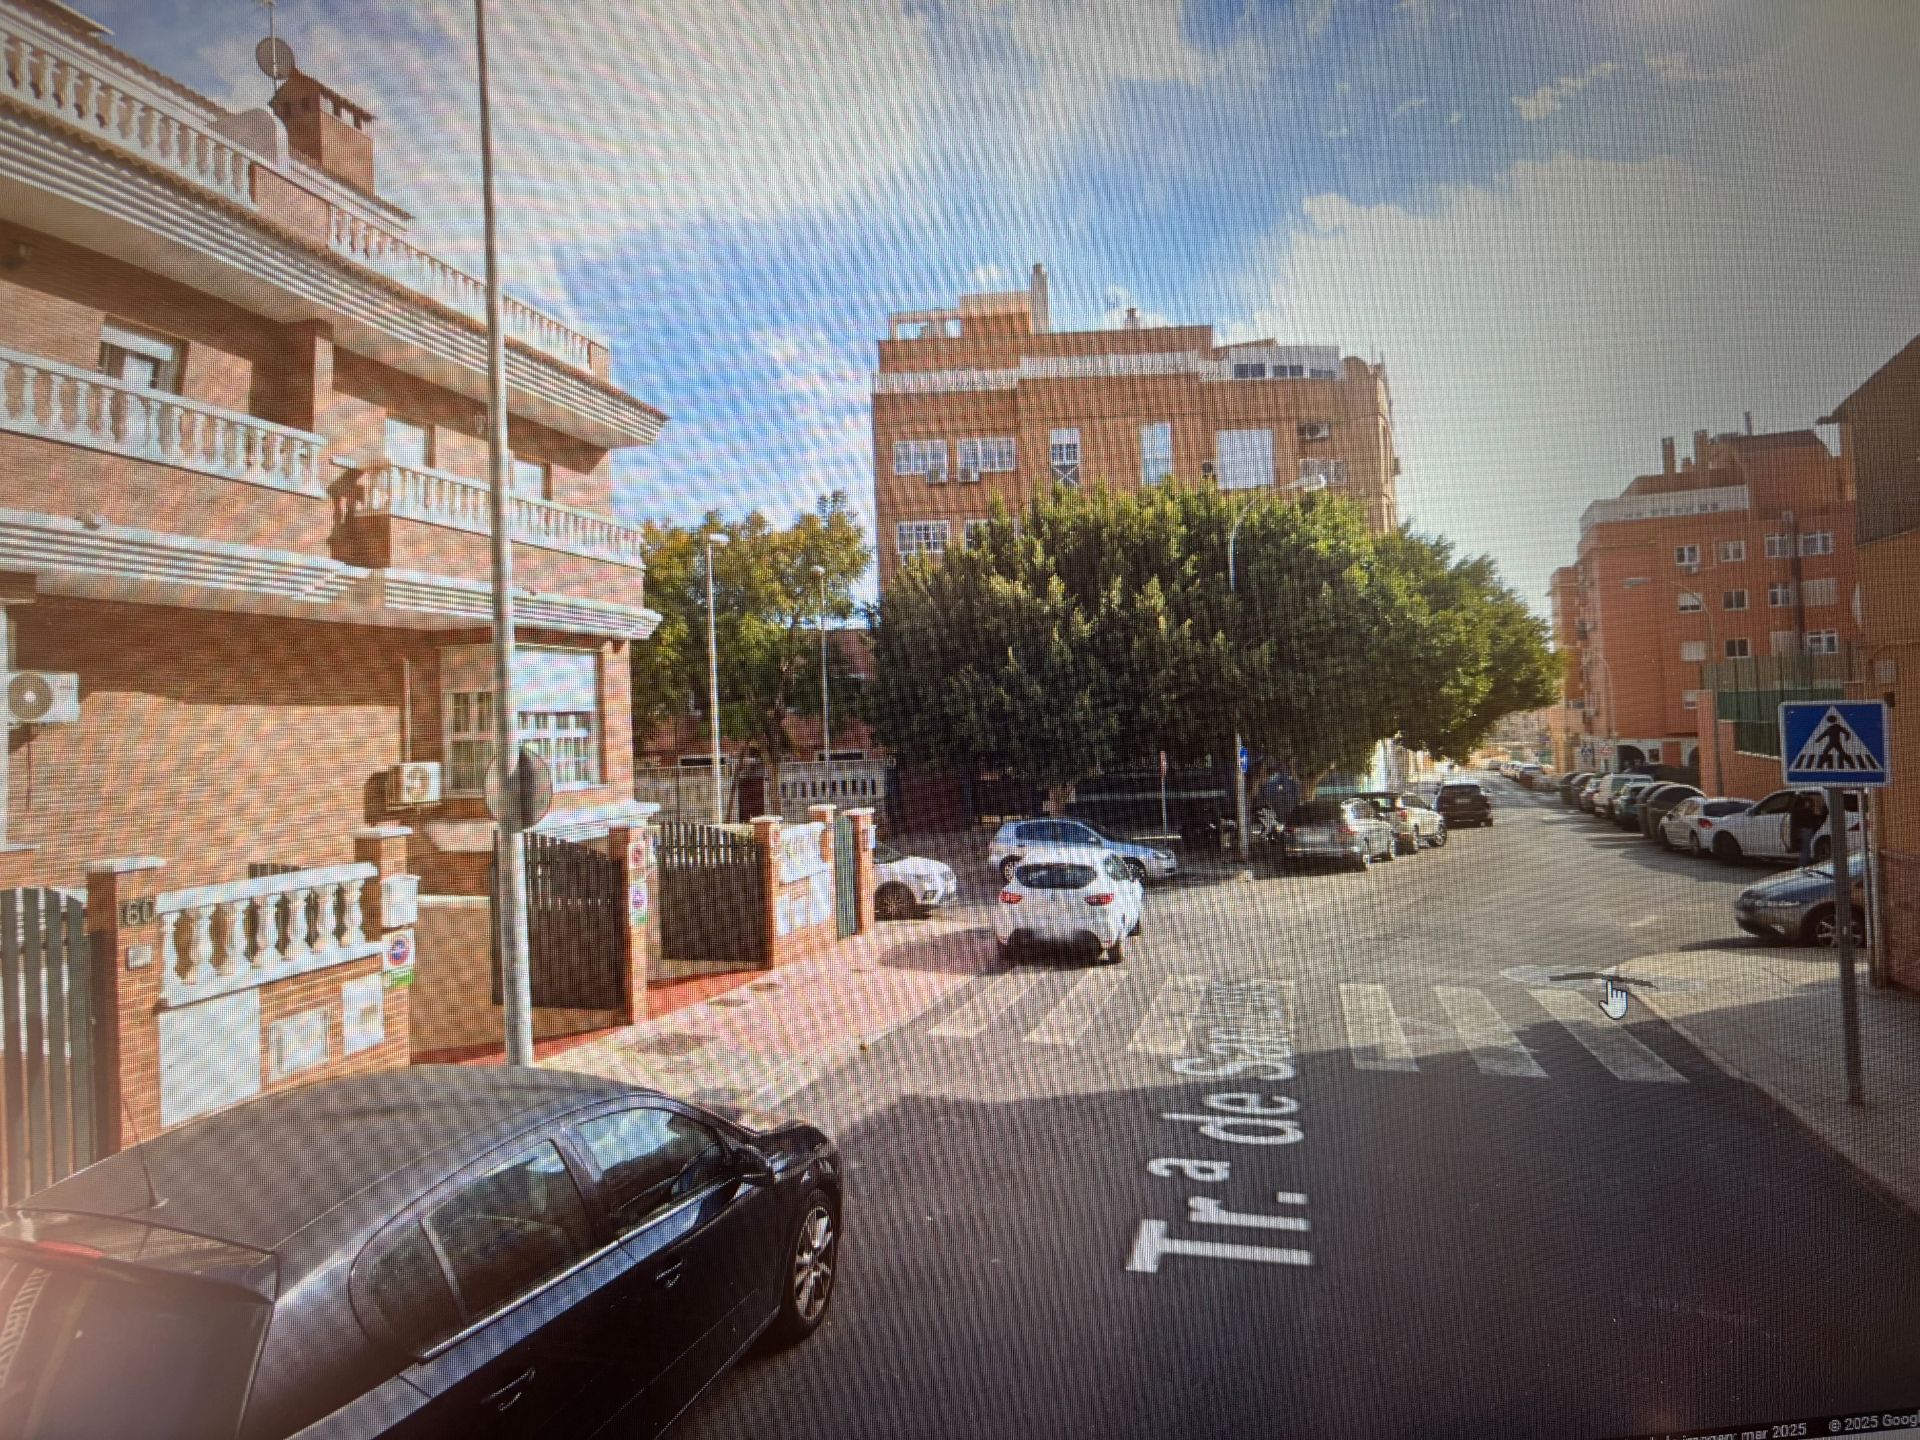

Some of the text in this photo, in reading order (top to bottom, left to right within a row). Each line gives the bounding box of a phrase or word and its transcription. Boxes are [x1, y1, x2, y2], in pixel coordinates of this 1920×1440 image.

[1161, 1092, 1304, 1145] de
[1741, 1430, 1769, 1440] mar
[1772, 1422, 1807, 1438] 2025
[1843, 1416, 1879, 1431] 2025
